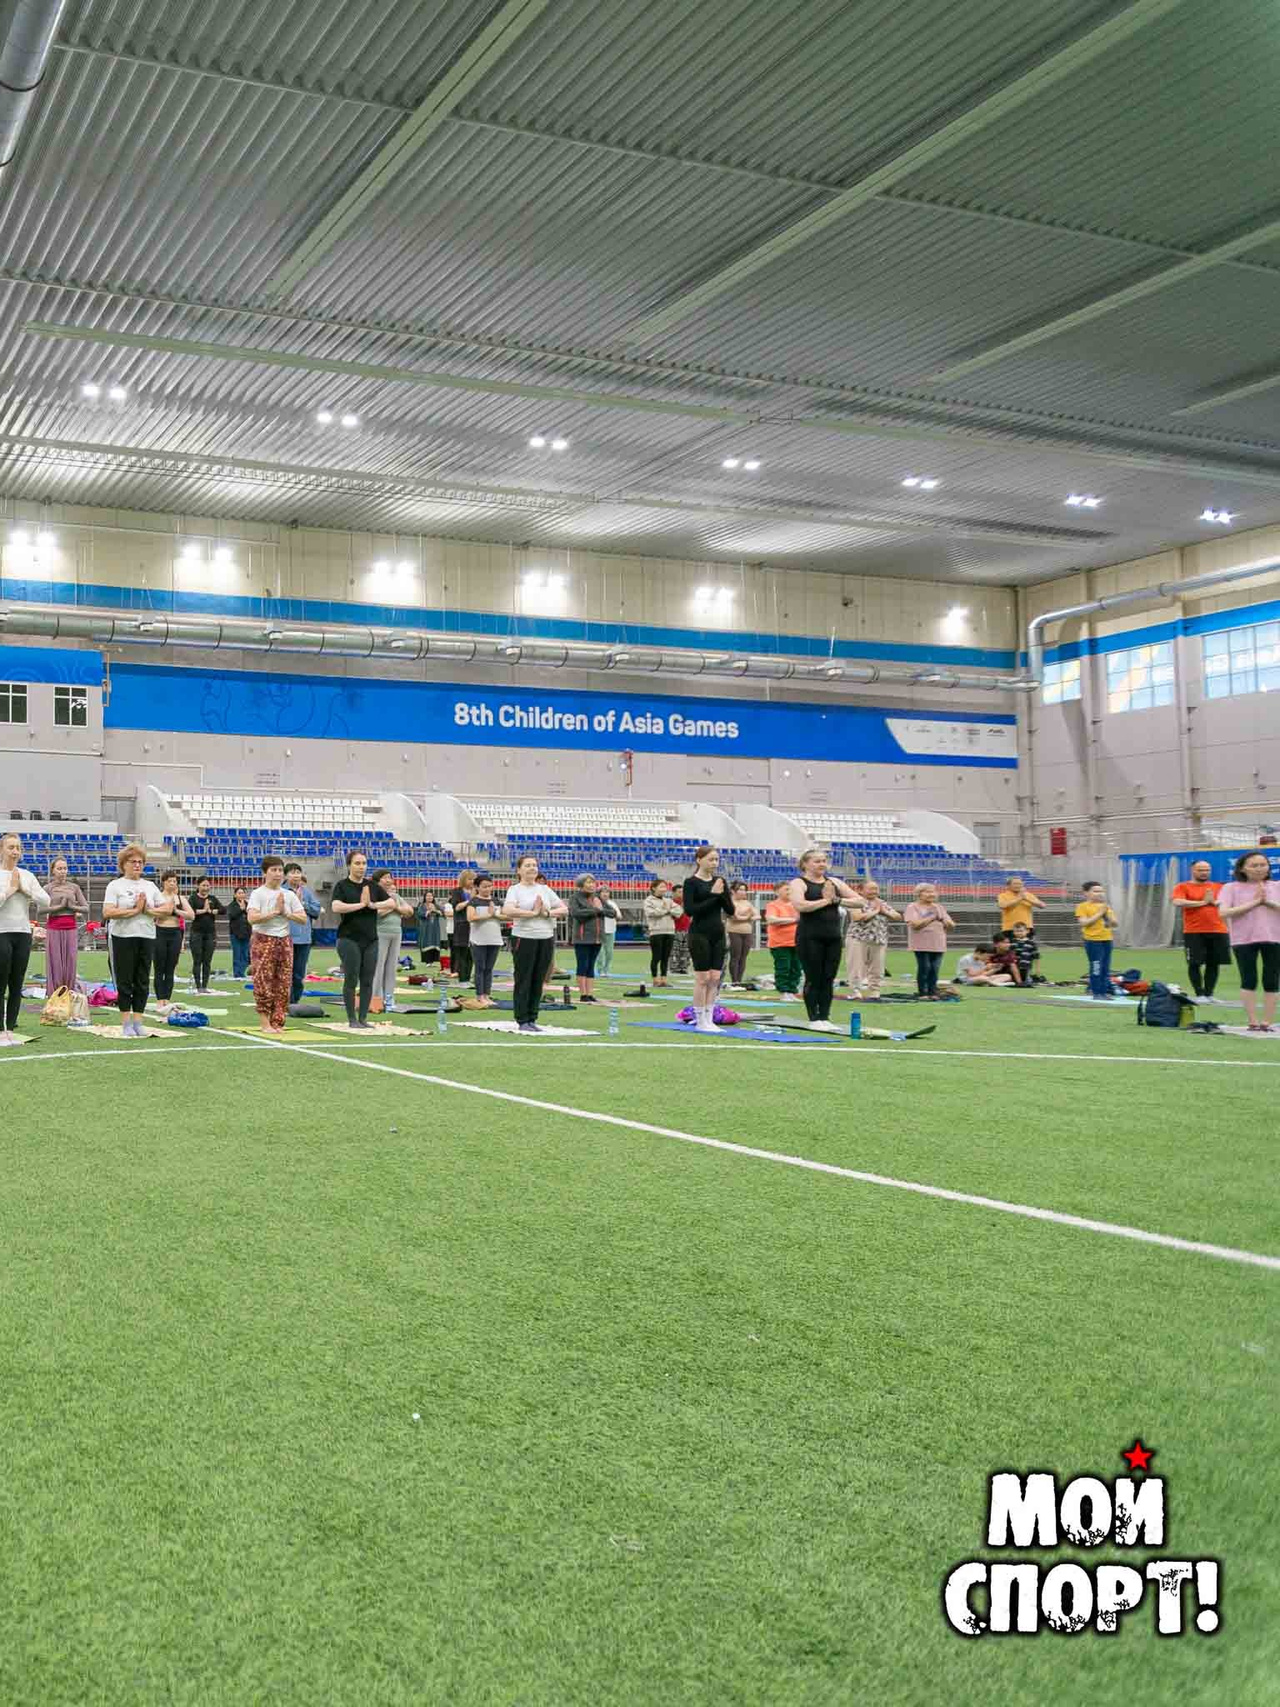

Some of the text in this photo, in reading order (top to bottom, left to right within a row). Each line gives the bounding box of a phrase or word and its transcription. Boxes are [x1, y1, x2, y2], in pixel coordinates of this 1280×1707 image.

[454, 702, 739, 738] 8th Children of Asia Games
